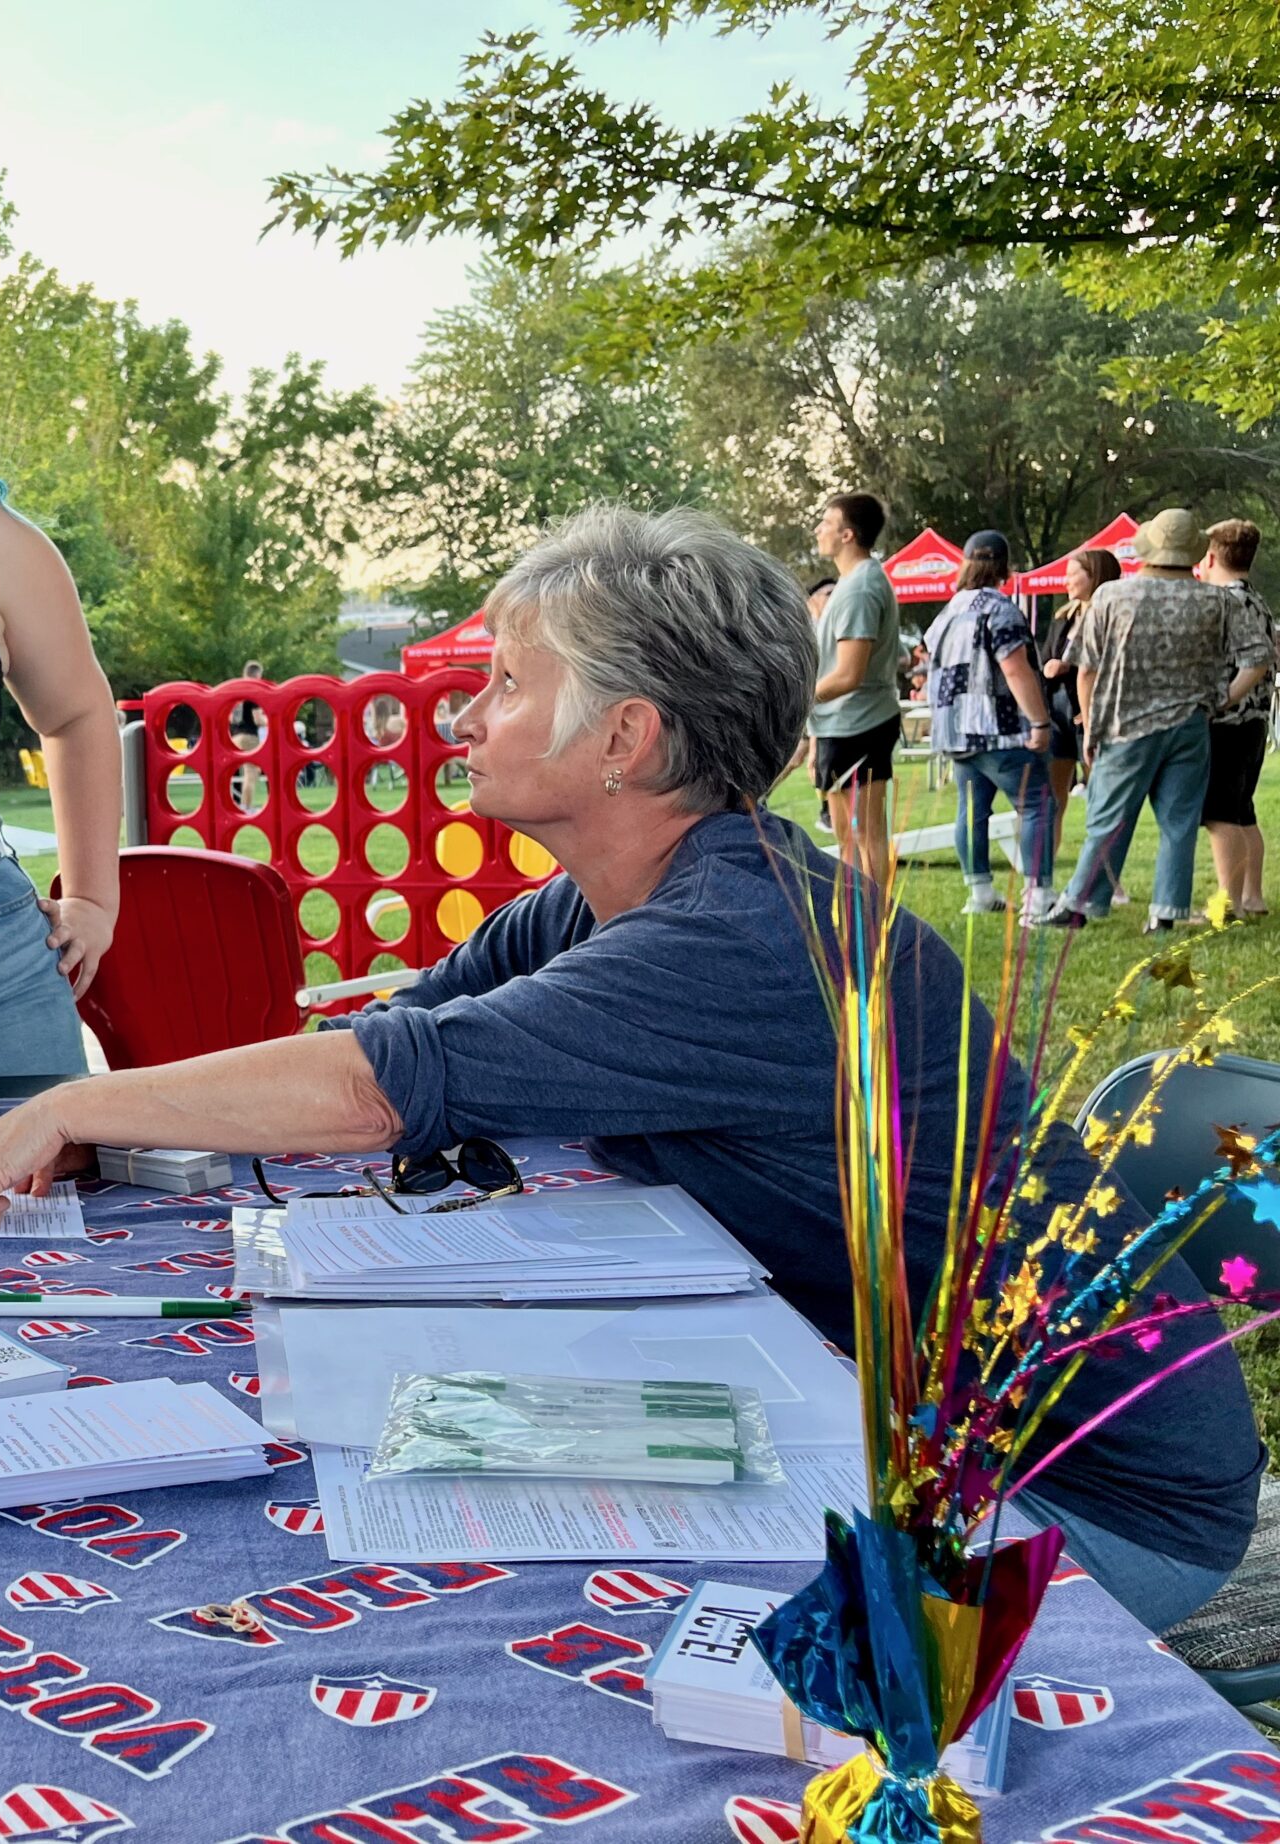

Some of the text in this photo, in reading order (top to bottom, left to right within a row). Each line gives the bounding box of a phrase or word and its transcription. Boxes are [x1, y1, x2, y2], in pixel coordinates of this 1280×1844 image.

[894, 582, 946, 595] BREWING
[149, 1561, 519, 1646] VOTE
[677, 1605, 761, 1666] VOTE!
